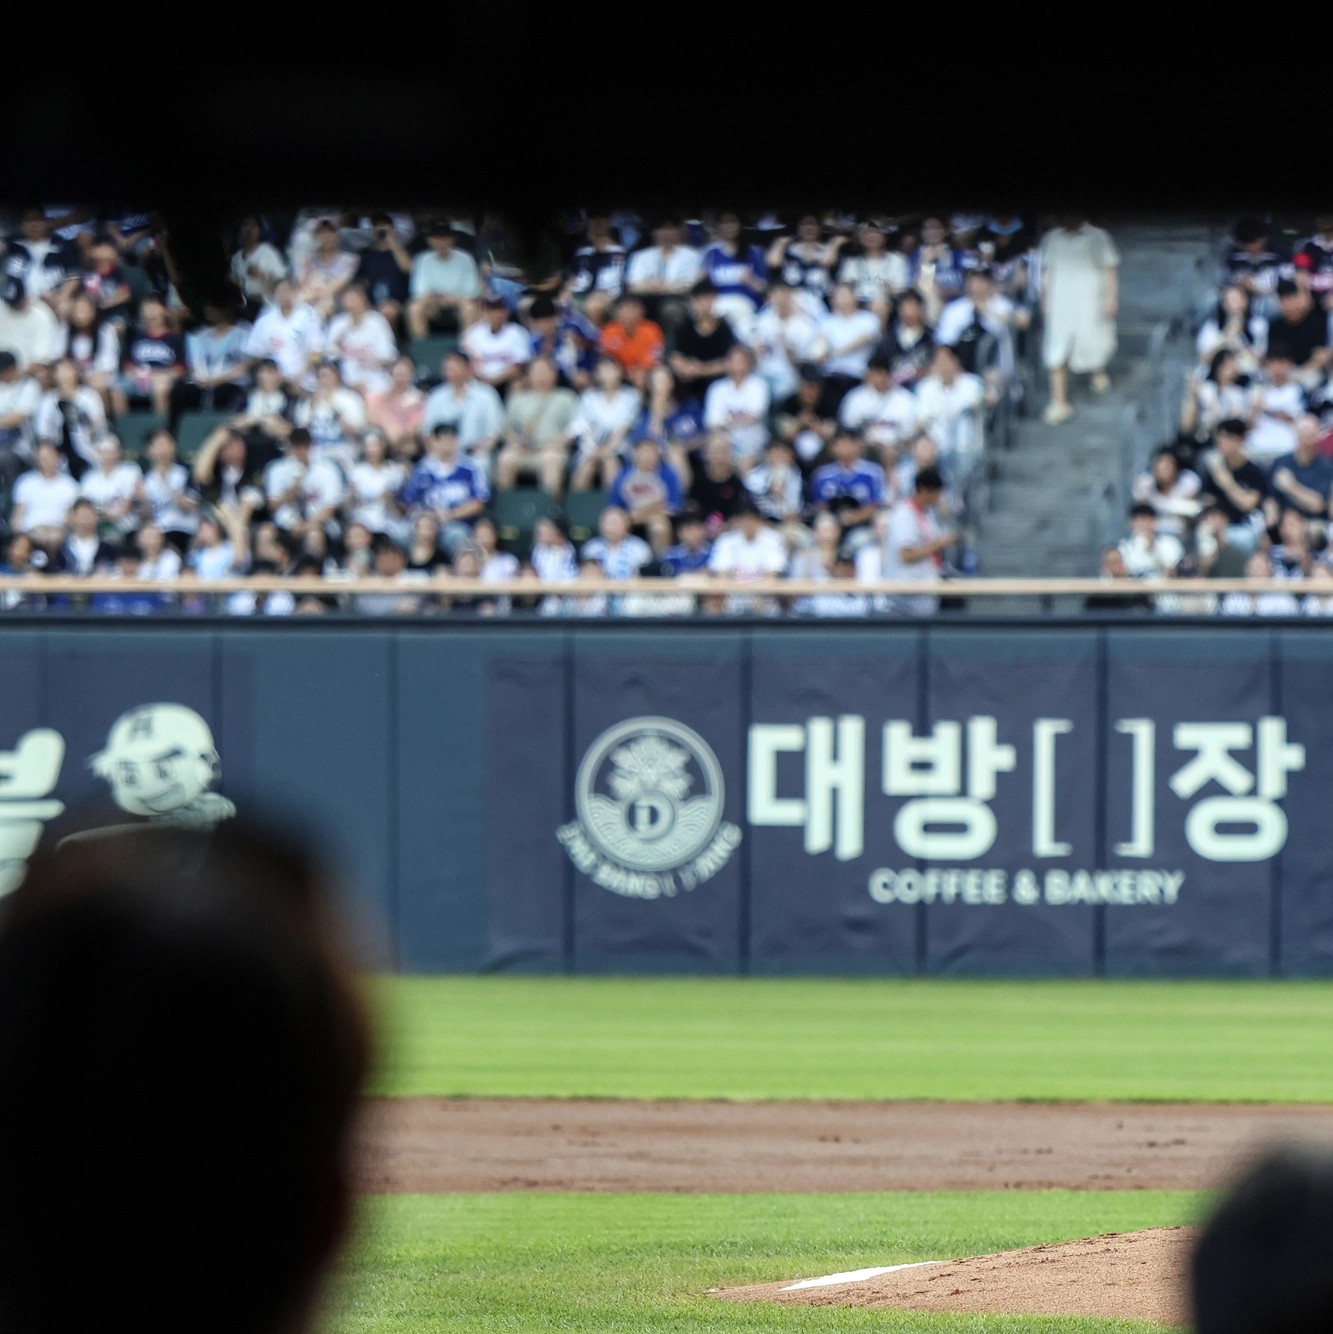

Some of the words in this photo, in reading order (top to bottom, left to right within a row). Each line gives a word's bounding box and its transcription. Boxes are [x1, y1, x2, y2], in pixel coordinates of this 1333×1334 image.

[868, 867, 1008, 904] COFFEE
[1012, 868, 1041, 904] &
[1044, 868, 1186, 904] BAKERY
